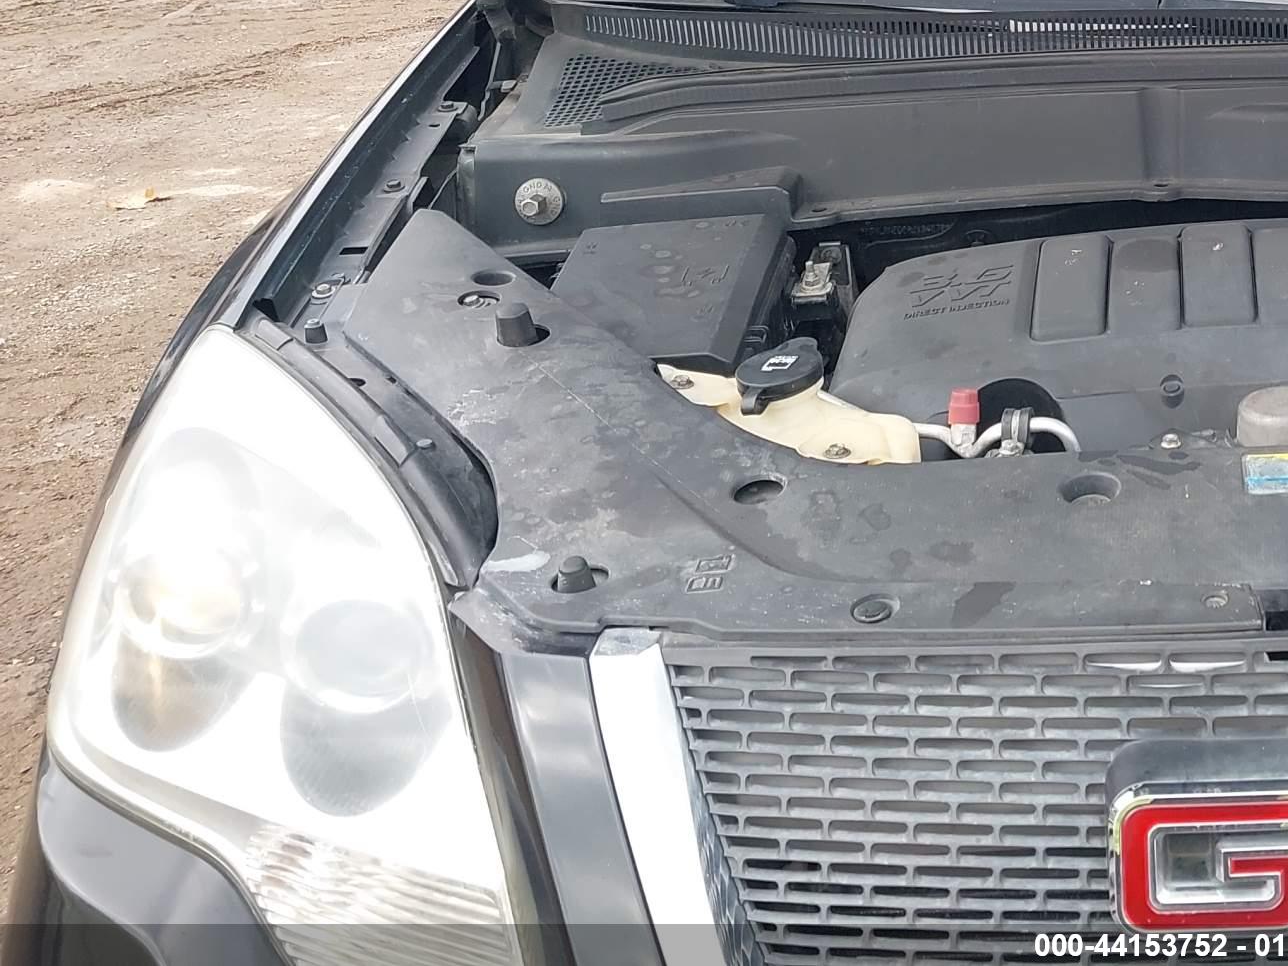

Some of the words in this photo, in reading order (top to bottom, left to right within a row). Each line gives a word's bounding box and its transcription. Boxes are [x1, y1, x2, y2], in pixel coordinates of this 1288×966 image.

[909, 281, 1012, 308] VVT
[903, 306, 947, 321] DIRECT
[948, 298, 1011, 314] INJECTION
